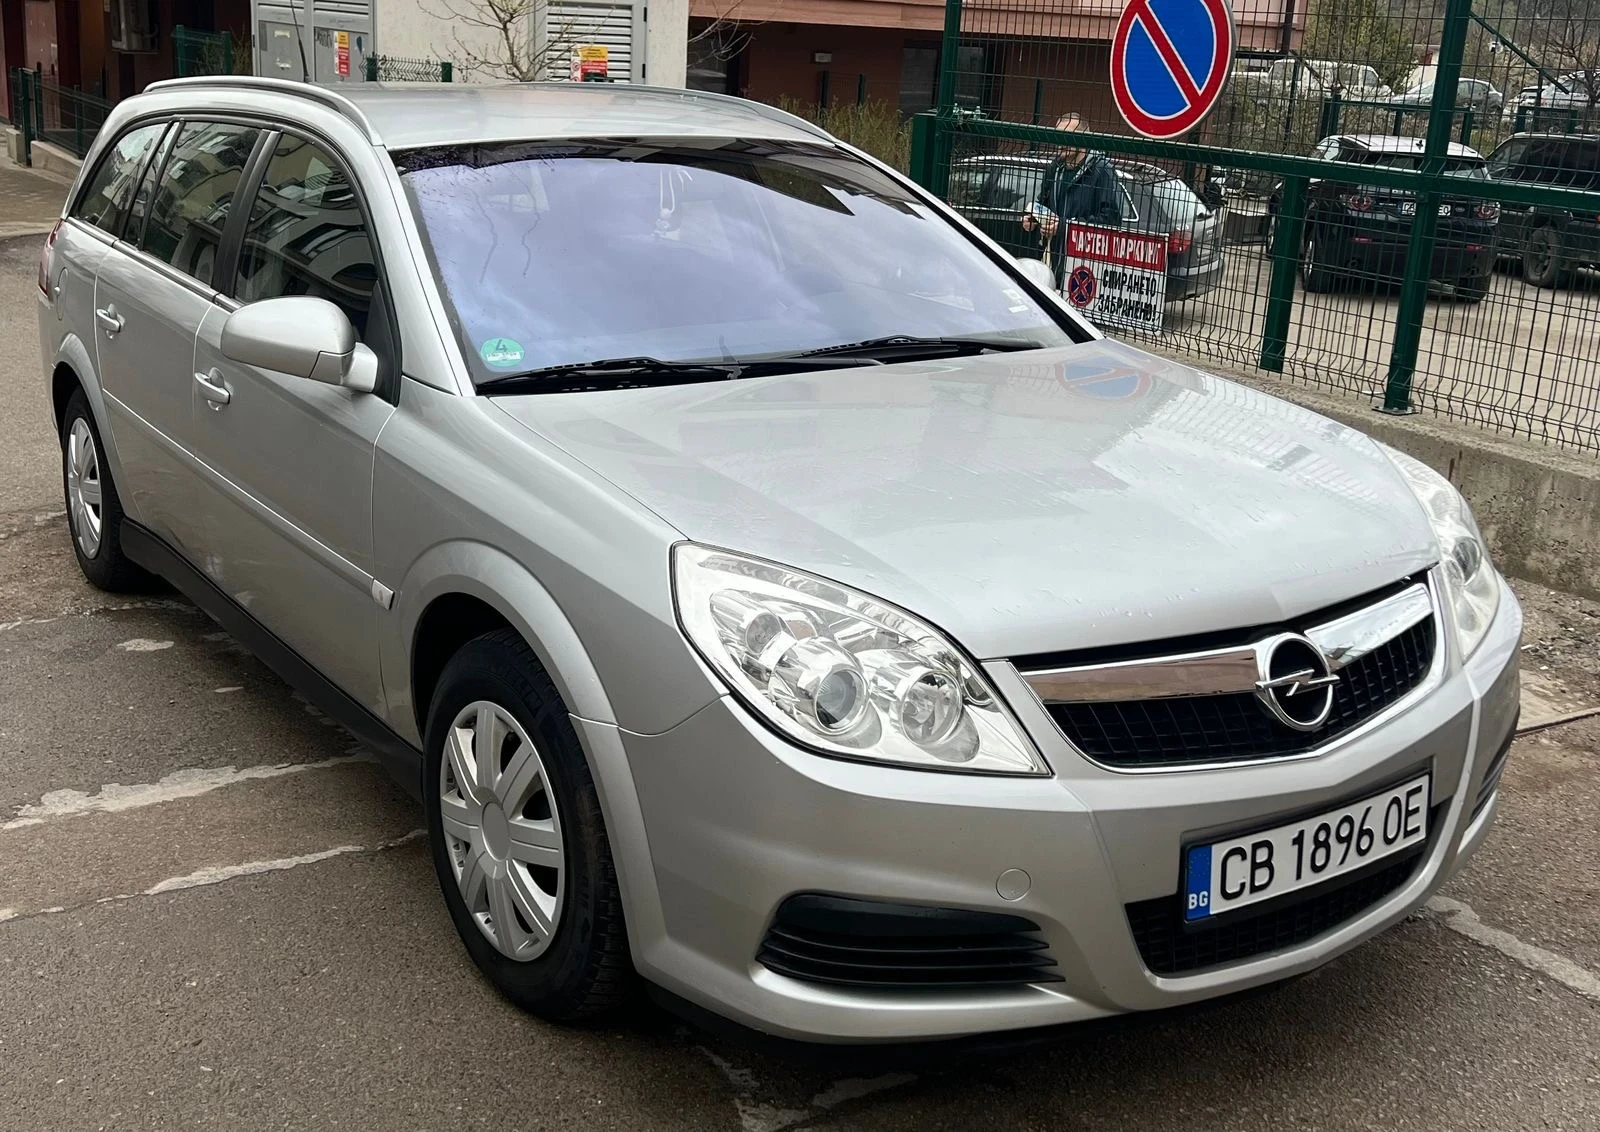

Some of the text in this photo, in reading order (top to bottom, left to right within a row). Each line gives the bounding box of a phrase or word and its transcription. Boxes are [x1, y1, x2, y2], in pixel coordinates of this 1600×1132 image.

[1071, 229, 1162, 265] ЧАСТЕН ПАРКИНГ
[1102, 268, 1157, 298] СПИРАНЕТО
[1098, 293, 1157, 323] ЗАБРАНЕНО!
[495, 338, 508, 353] 4
[1220, 784, 1424, 901] CB 1896 OE
[1187, 891, 1209, 910] BG
